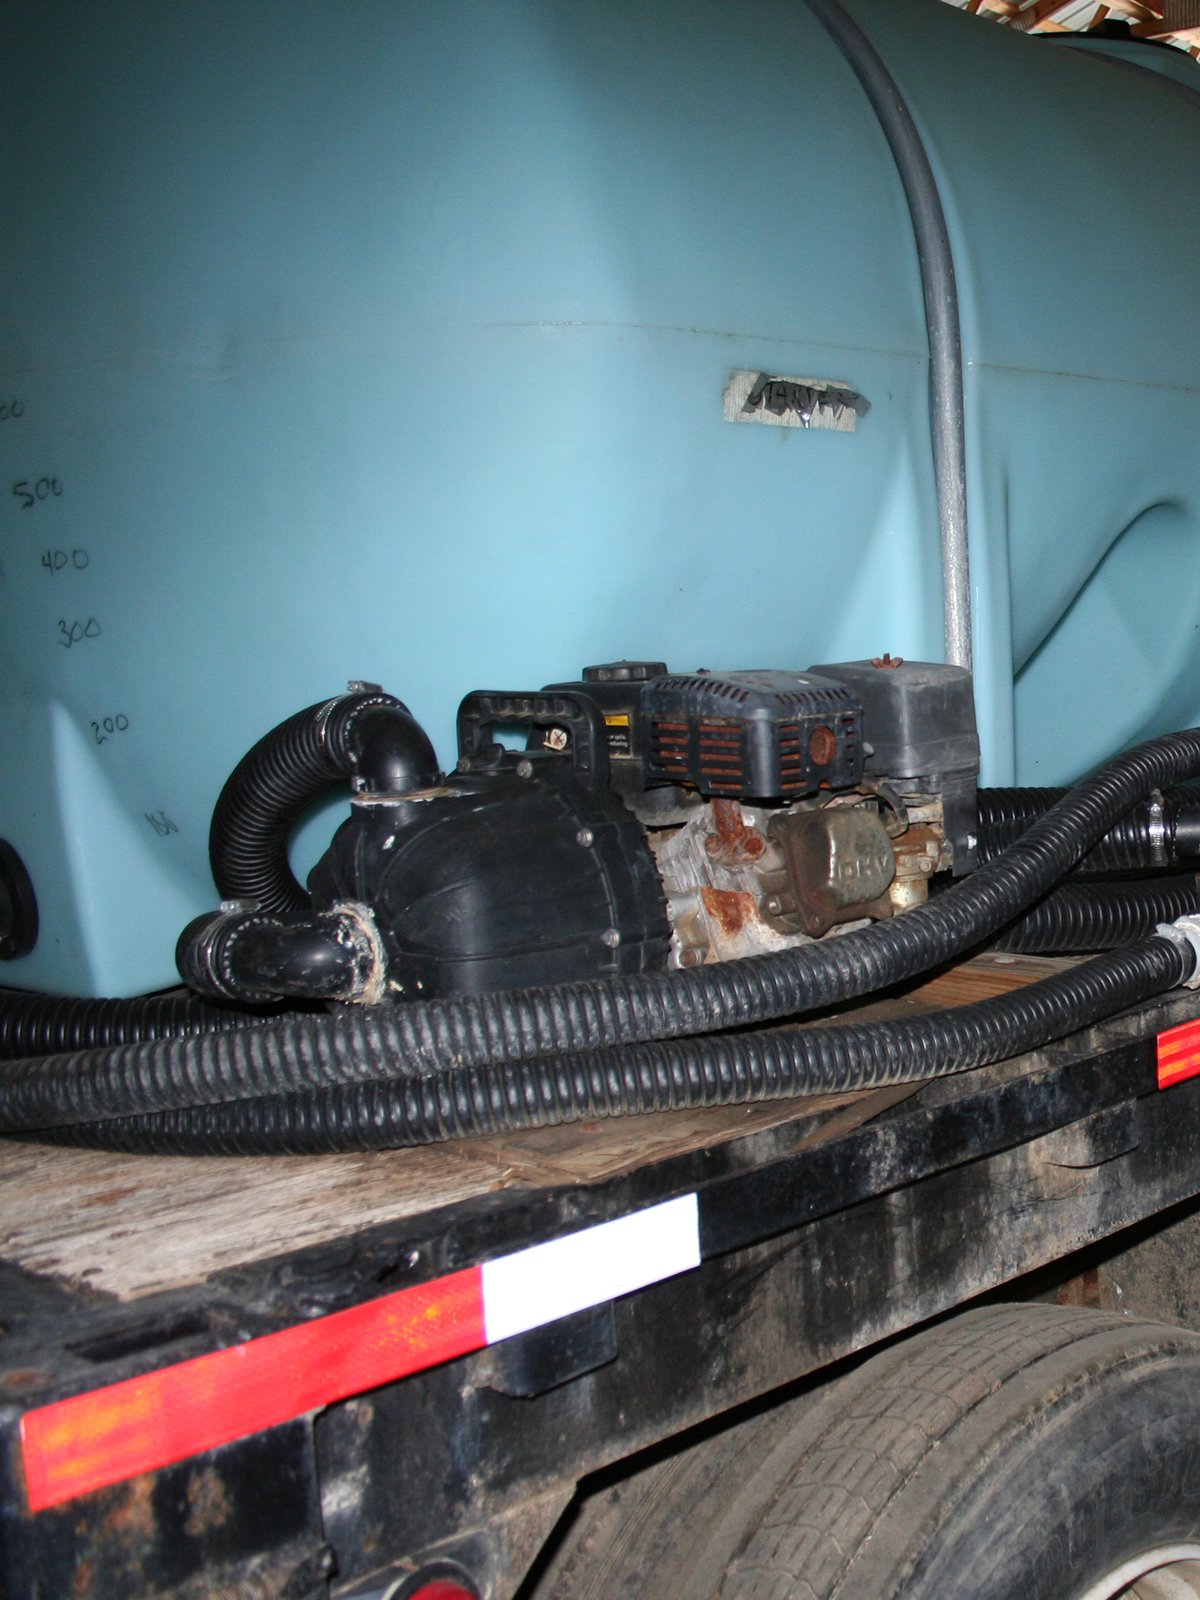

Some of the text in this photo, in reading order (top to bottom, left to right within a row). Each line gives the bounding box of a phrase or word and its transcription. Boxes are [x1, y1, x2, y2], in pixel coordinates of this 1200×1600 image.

[11, 477, 63, 510] 500
[42, 549, 89, 576] 400
[57, 619, 101, 648] 300
[91, 714, 129, 744] 200
